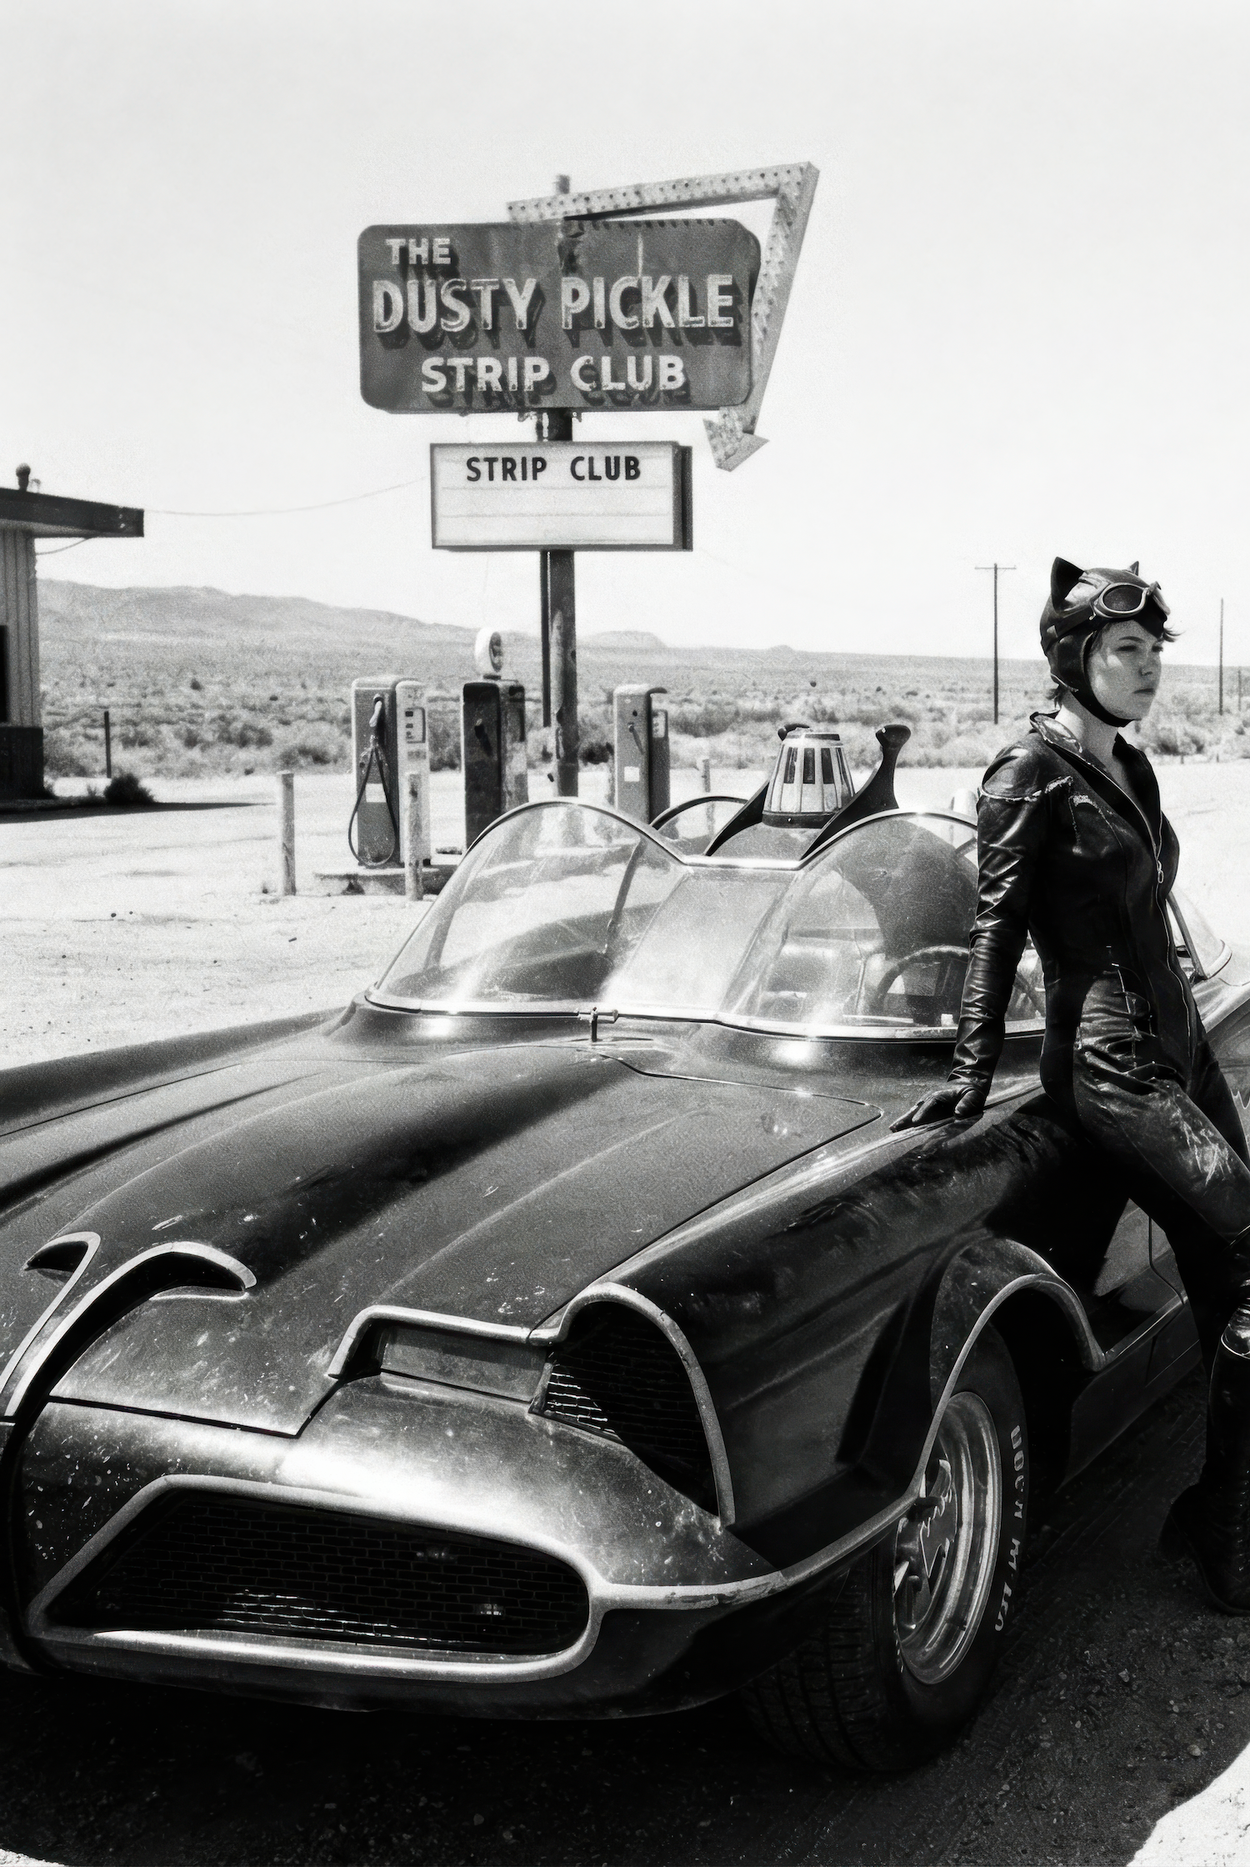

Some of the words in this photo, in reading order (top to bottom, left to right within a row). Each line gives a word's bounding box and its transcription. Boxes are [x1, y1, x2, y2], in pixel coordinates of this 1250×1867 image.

[386, 238, 452, 265] THE
[372, 278, 537, 333] DUSTY
[561, 274, 735, 330] PICKLE
[421, 356, 550, 393] STRIP
[570, 355, 686, 391] CLUB
[466, 456, 548, 482] STRIP
[570, 455, 642, 481] CLUB
